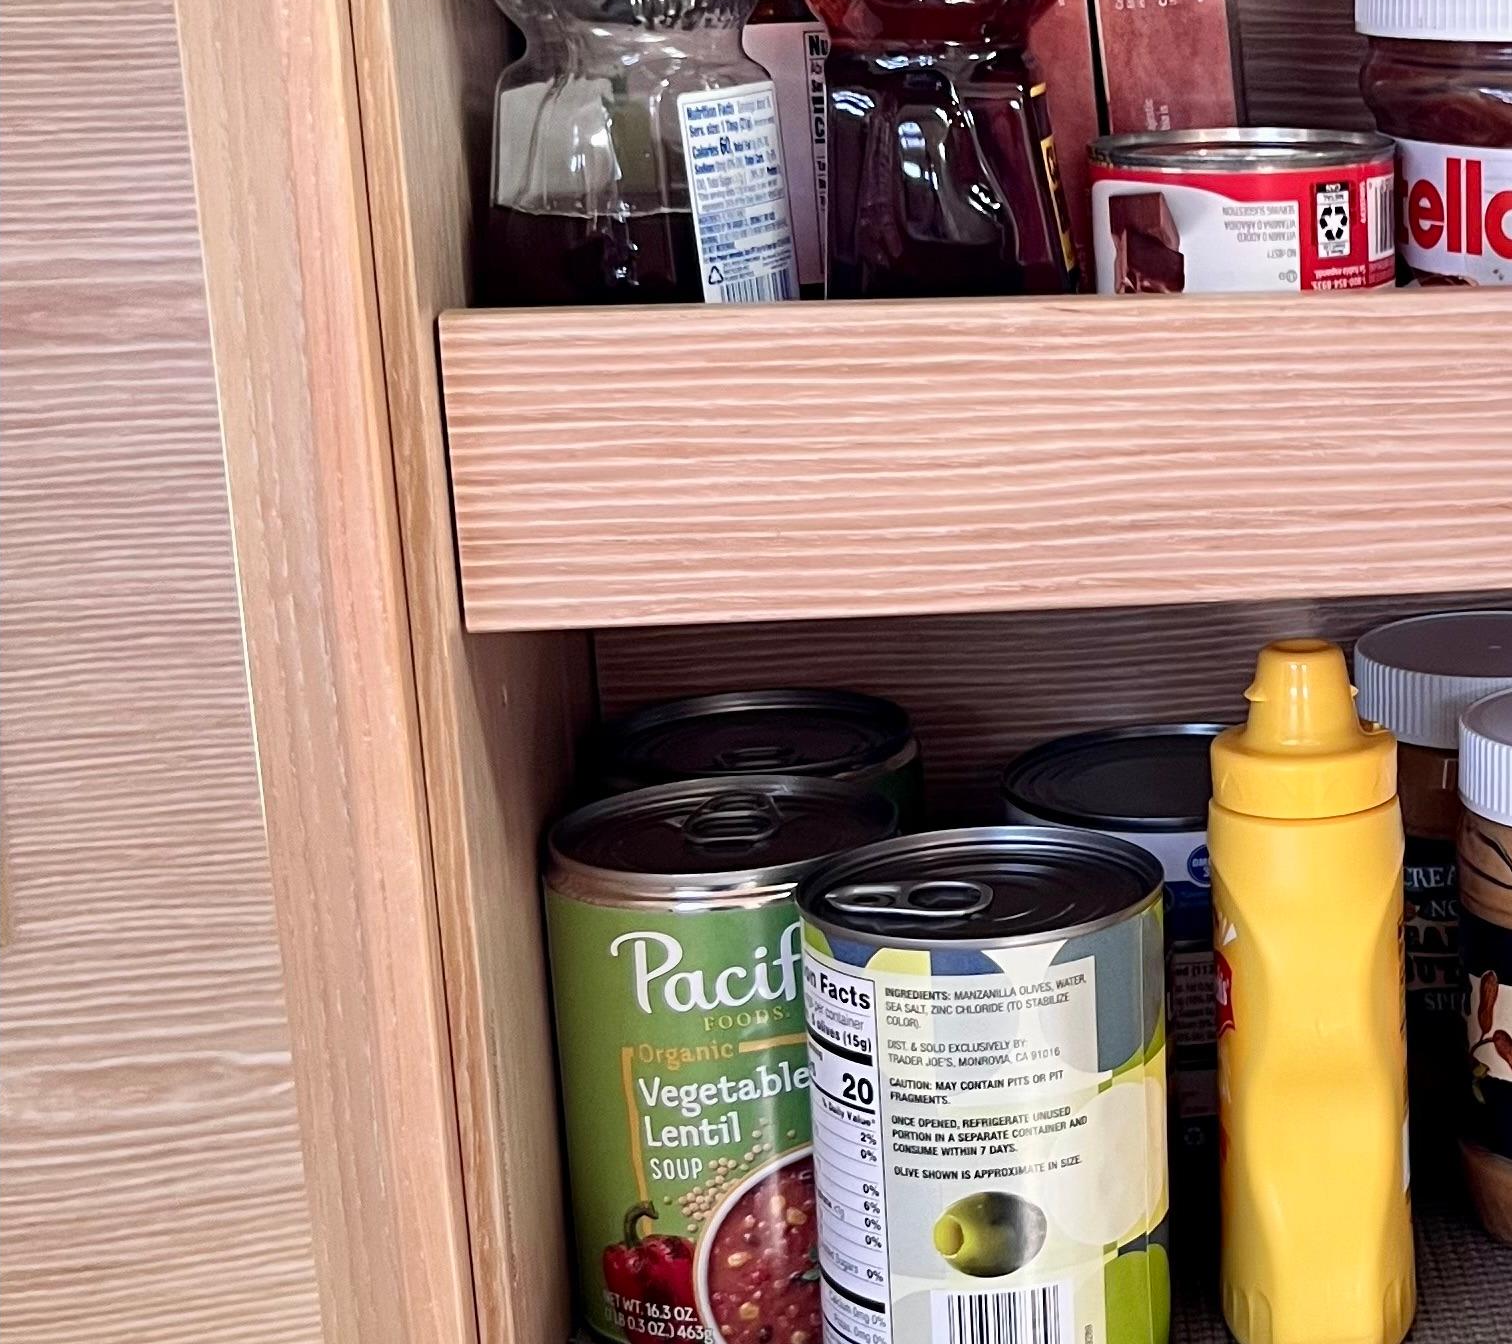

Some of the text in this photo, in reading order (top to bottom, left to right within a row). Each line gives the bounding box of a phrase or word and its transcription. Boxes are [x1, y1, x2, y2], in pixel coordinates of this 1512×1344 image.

[820, 972, 871, 1010] Facts
[884, 973, 1087, 1001] INGREDIENTS: MANZANILLA OLIVES, WATER,
[885, 992, 1070, 1016] SEA SALT, ZINC CHLORIDE (TO STABILIZE
[825, 1003, 865, 1031] container
[816, 1018, 872, 1053] olives (15g)
[911, 1041, 918, 1052] &
[920, 1042, 946, 1053] SOLD
[948, 1040, 1011, 1053] EXCLUSIVELY
[638, 1039, 734, 1071] Organic
[888, 1046, 1061, 1069] TRADER JOE'S, MONROVIA, CA 91016
[638, 1061, 811, 1117] Vegetable
[842, 1072, 874, 1105] 20
[889, 1069, 1064, 1092] CAUTION: MAY CONTAIN PITS OR PIT
[890, 1091, 951, 1105] FRAGMENTS.
[644, 1111, 741, 1148] Lentil
[891, 1106, 1071, 1130] ONCE OPENED, REFRIGERATE UNUSED
[892, 1115, 1088, 1142] PORTION IN A SEPARATE CONTAINER AND
[860, 1132, 877, 1146] 2%
[892, 1142, 1018, 1156] CONSUME WITHIN 7 DAYS.
[860, 1149, 877, 1162] 0%
[894, 1154, 1083, 1180] OLIVE SHOWN IS APPROXIMATE IN SIZE.
[650, 1158, 703, 1180] SOUP
[862, 1183, 880, 1197] 0%
[863, 1200, 881, 1214] 6%
[864, 1217, 882, 1231] 0%
[865, 1234, 882, 1249] 0%
[866, 1268, 884, 1282] 0%
[646, 1302, 671, 1319] 16.3
[674, 1307, 698, 1321] OZ.
[871, 1314, 887, 1328] 0%
[628, 1316, 646, 1333] 0.3
[677, 1325, 714, 1344] 463g
